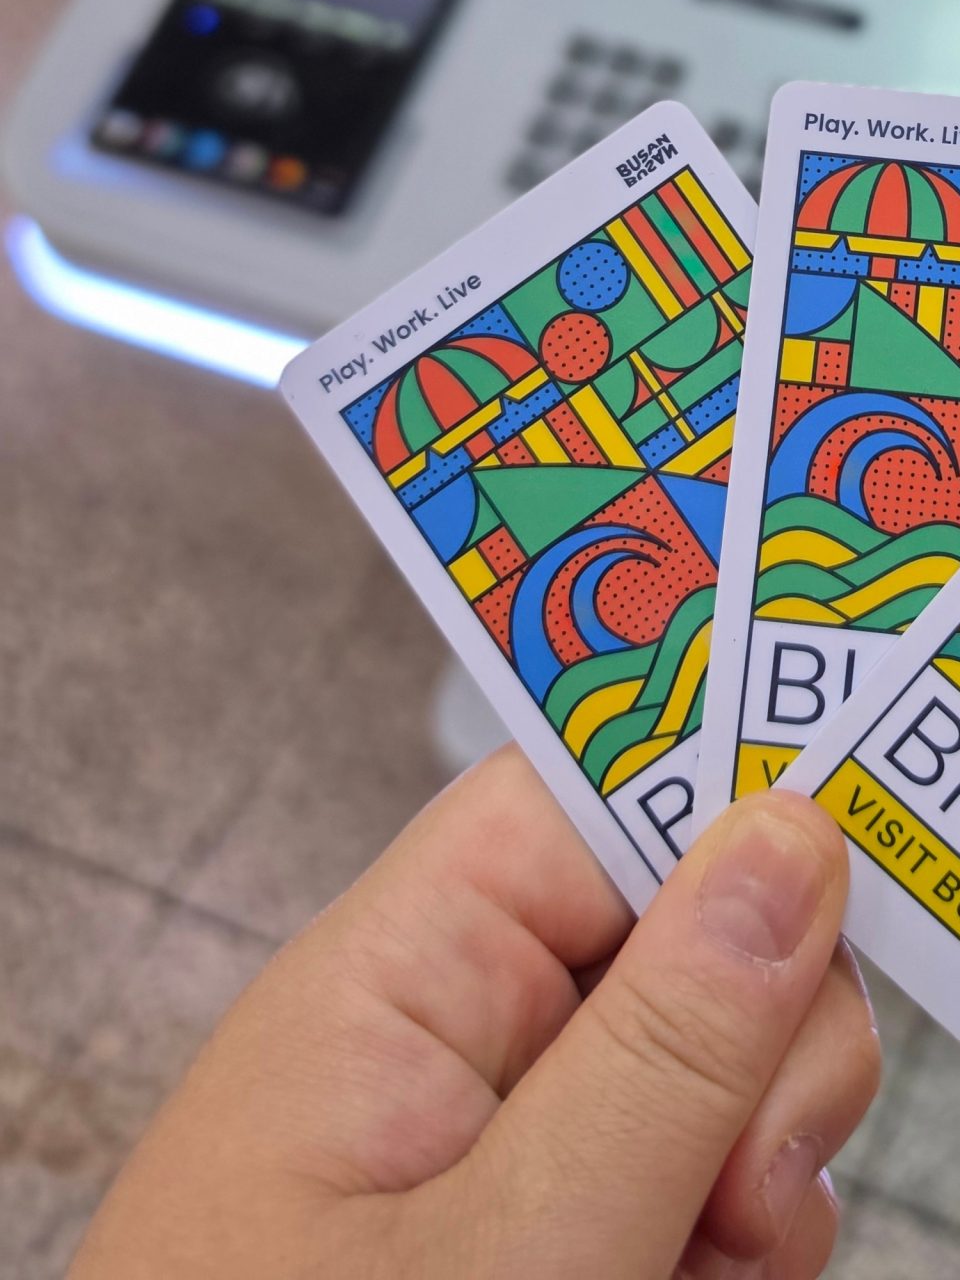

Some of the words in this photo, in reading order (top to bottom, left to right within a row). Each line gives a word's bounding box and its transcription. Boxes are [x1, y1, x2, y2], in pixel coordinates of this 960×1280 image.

[615, 133, 672, 178] BUSAN
[804, 112, 859, 141] Play.
[867, 118, 935, 143] Work.
[318, 353, 375, 394] Play.
[371, 308, 439, 355] Work.
[436, 274, 482, 311] Live
[766, 641, 856, 726] BI
[847, 785, 939, 875] VISIT
